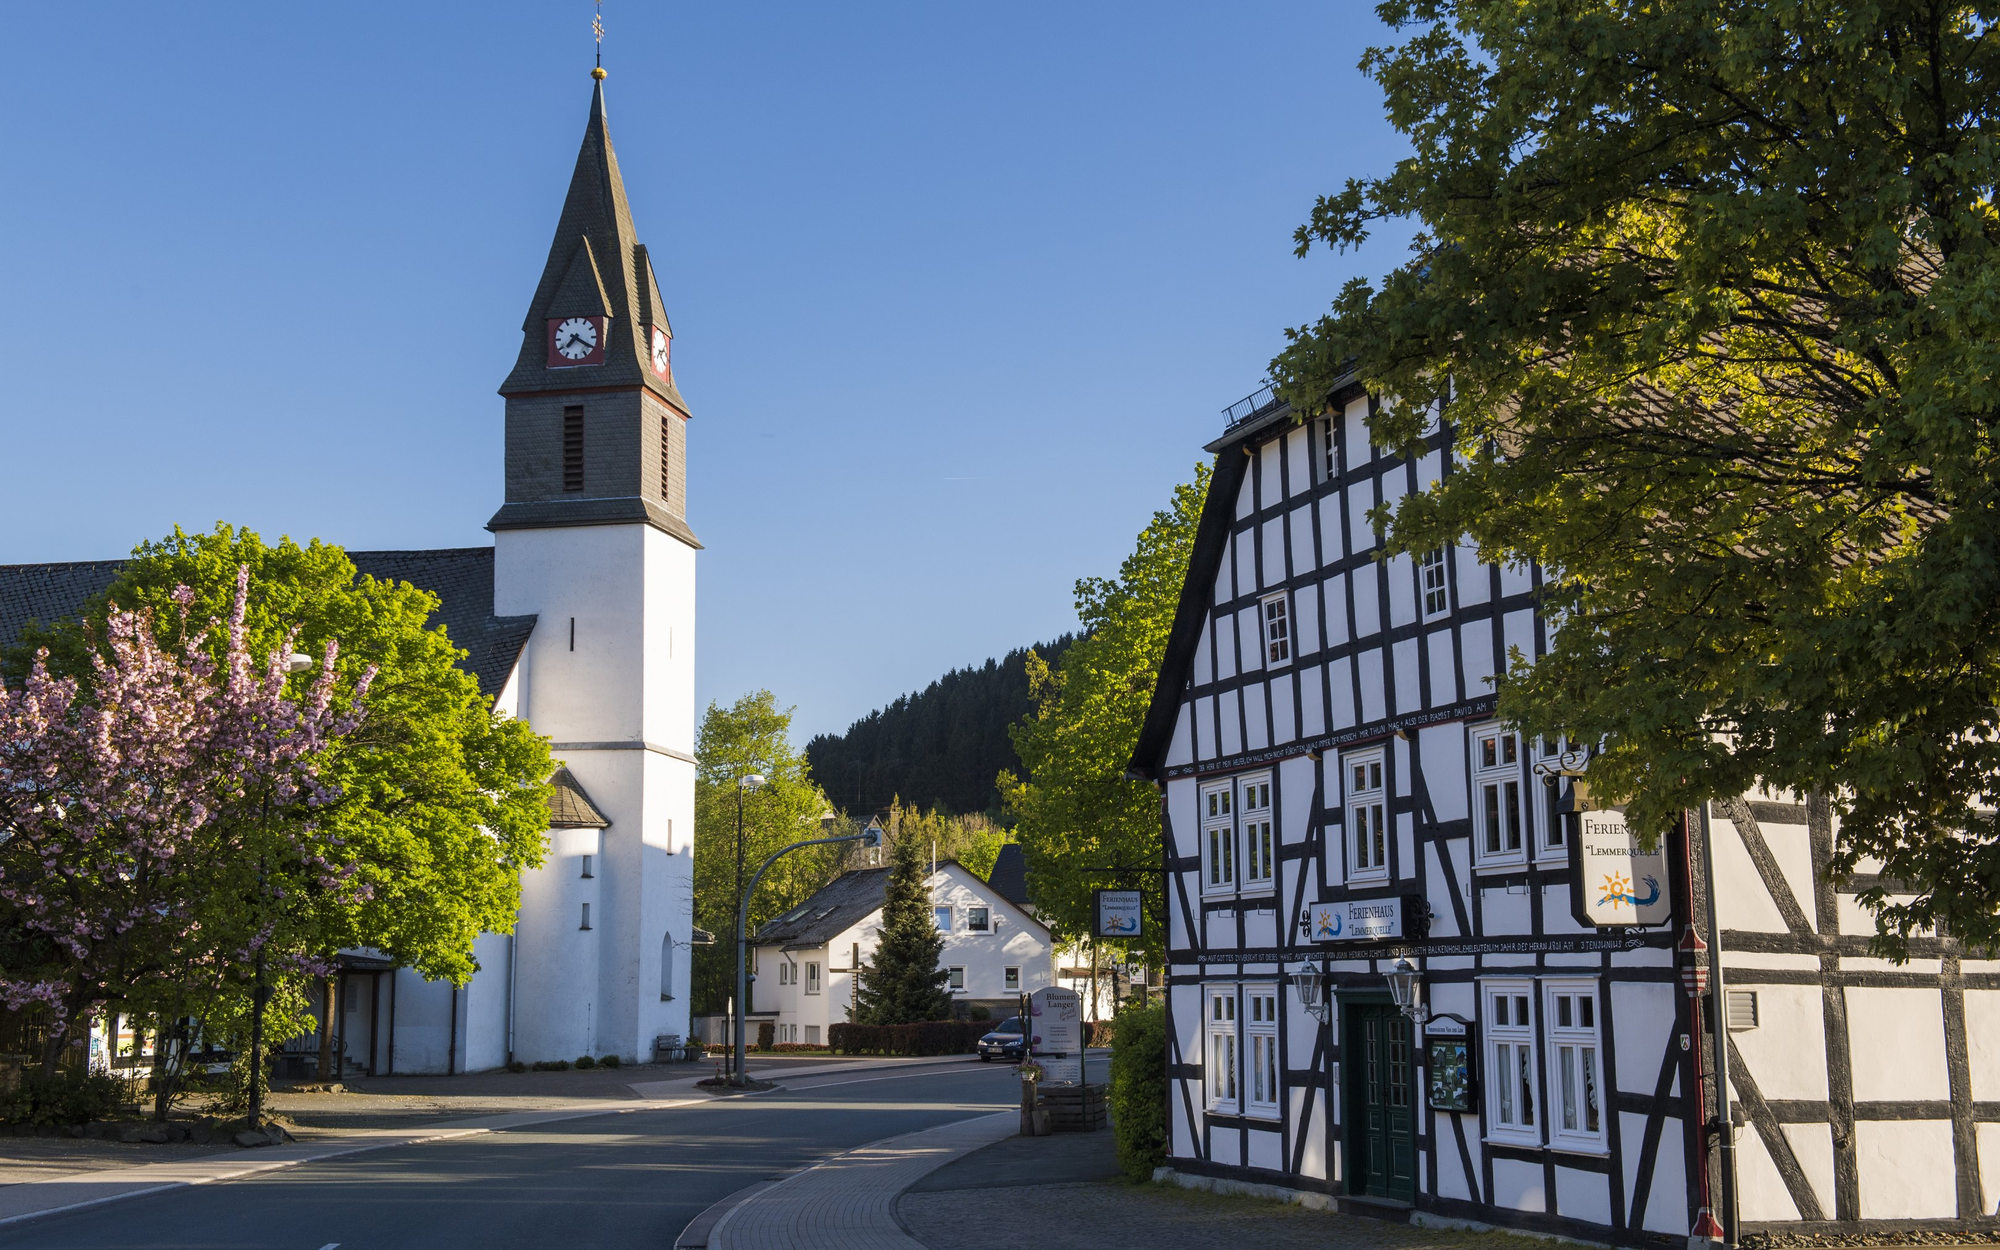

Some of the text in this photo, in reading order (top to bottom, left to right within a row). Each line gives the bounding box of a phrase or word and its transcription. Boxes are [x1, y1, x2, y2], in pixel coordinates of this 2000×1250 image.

[1360, 729, 1369, 738] MIR
[1388, 721, 1400, 732] MAG
[1405, 718, 1416, 726] ALSO
[1418, 715, 1428, 724] DER
[1454, 706, 1472, 717] DAVID
[1476, 702, 1486, 712] AM
[1586, 845, 1663, 857] “LEMMERQUELE”
[1103, 895, 1138, 903] FERIENHAUS
[1348, 903, 1394, 919] FERIENHAUS
[1386, 948, 1400, 956] UND
[1500, 942, 1516, 952] JAHR
[1517, 942, 1527, 951] DES
[1048, 1001, 1075, 1009] Langer
